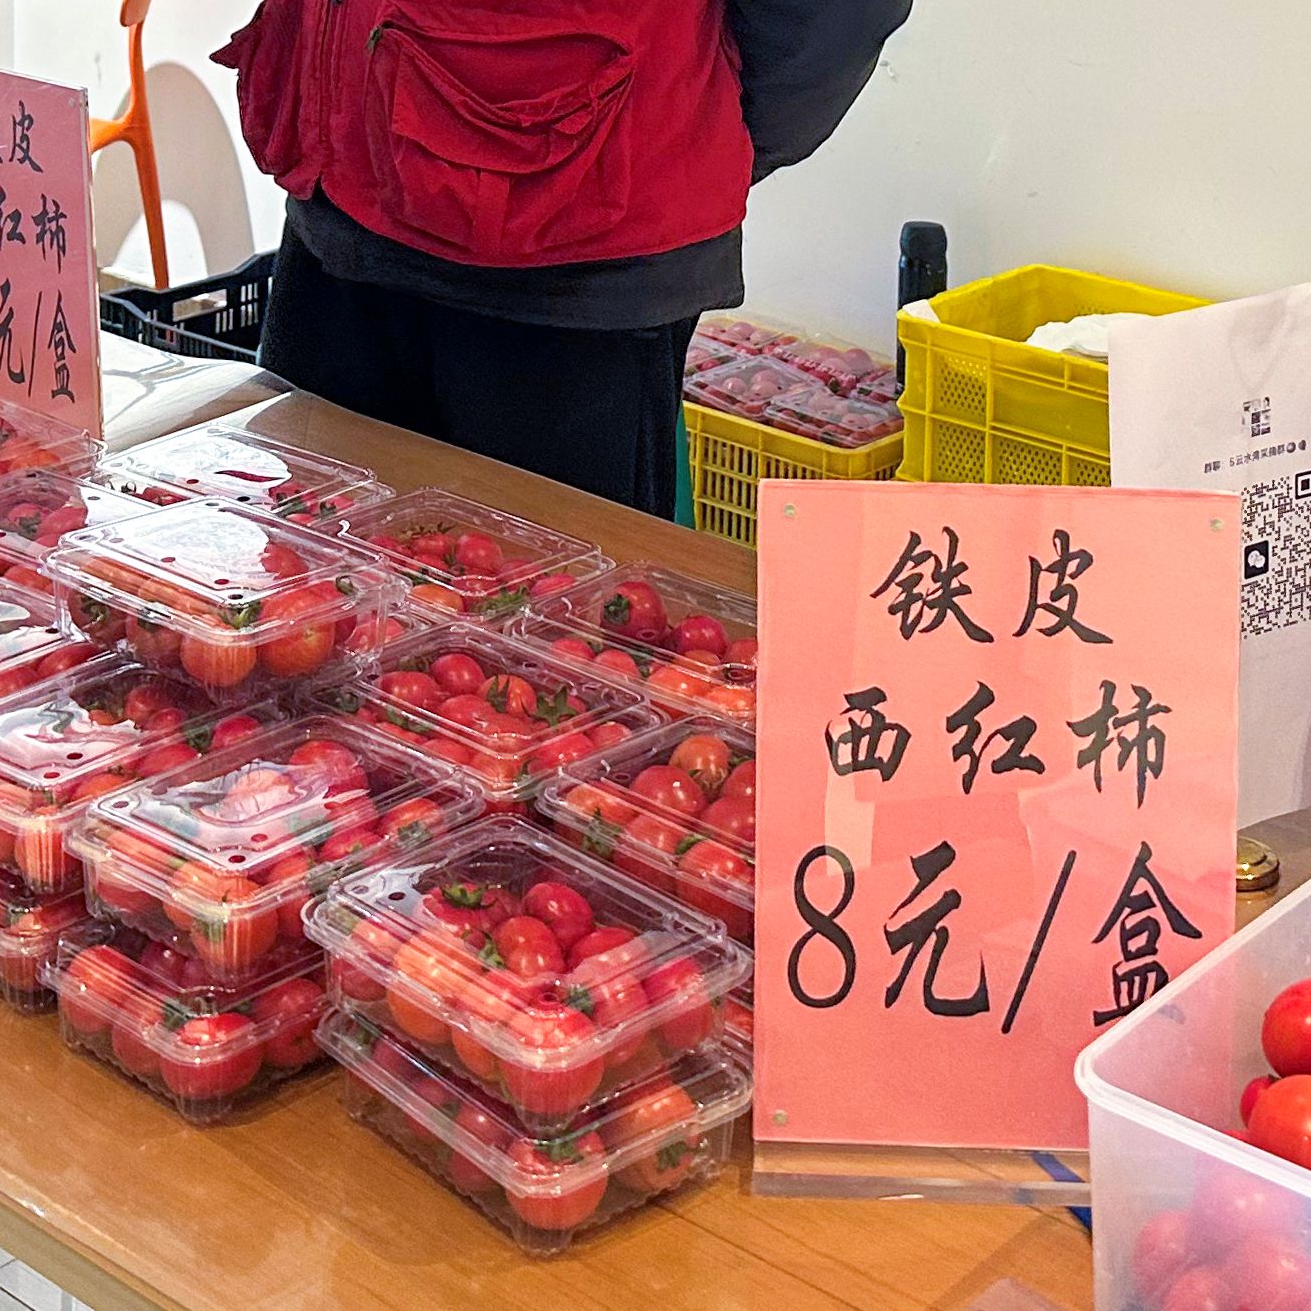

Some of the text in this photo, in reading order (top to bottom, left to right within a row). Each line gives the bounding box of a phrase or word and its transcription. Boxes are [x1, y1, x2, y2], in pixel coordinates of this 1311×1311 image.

[869, 526, 1113, 646] 铁皮
[824, 680, 1171, 809] 西红柿
[788, 840, 1202, 1035] 8元/盒
